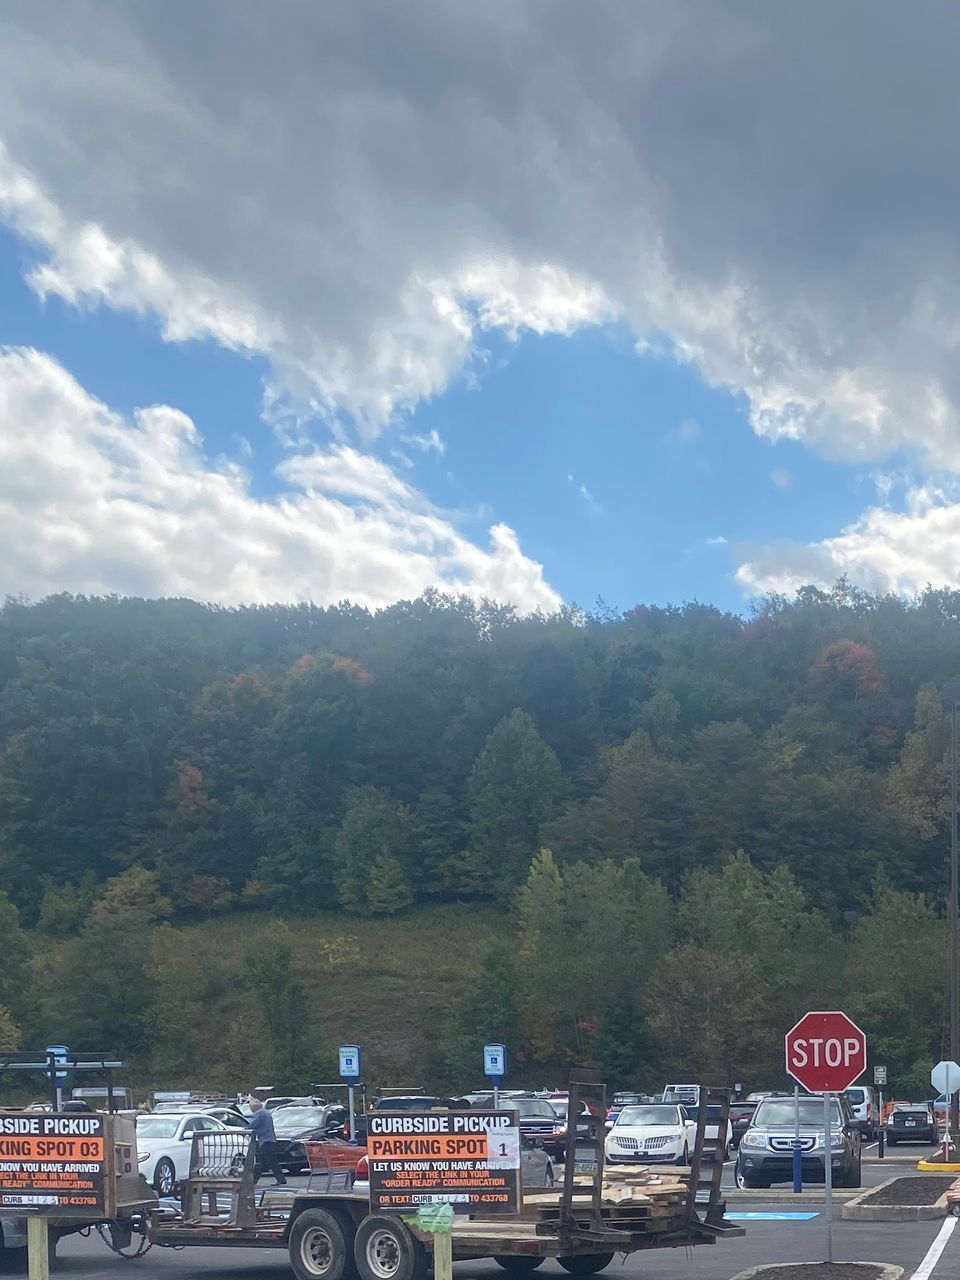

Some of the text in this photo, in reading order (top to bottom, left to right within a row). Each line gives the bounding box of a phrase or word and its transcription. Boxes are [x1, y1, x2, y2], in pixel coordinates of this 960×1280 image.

[792, 1037, 860, 1067] STOP
[44, 1119, 100, 1134] PICKUP
[372, 1117, 510, 1133] CURBSIDE PICKUP
[37, 1142, 75, 1156] SPOT
[80, 1142, 99, 1156] 03
[373, 1139, 487, 1155] PARKING SPOT
[499, 1143, 508, 1157] 1
[22, 1163, 38, 1172] YOU
[41, 1164, 63, 1172] HAVE
[65, 1164, 99, 1172] ARRIVED
[374, 1162, 512, 1171] LET US KNOW YOU HAVE ARRIVED
[32, 1180, 93, 1188] COMMUNICATION
[443, 1178, 505, 1186] COMMUNICATION
[379, 1195, 389, 1203] OR
[413, 1195, 433, 1203] CURB
[469, 1194, 480, 1202] TO
[481, 1194, 508, 1202] 433768
